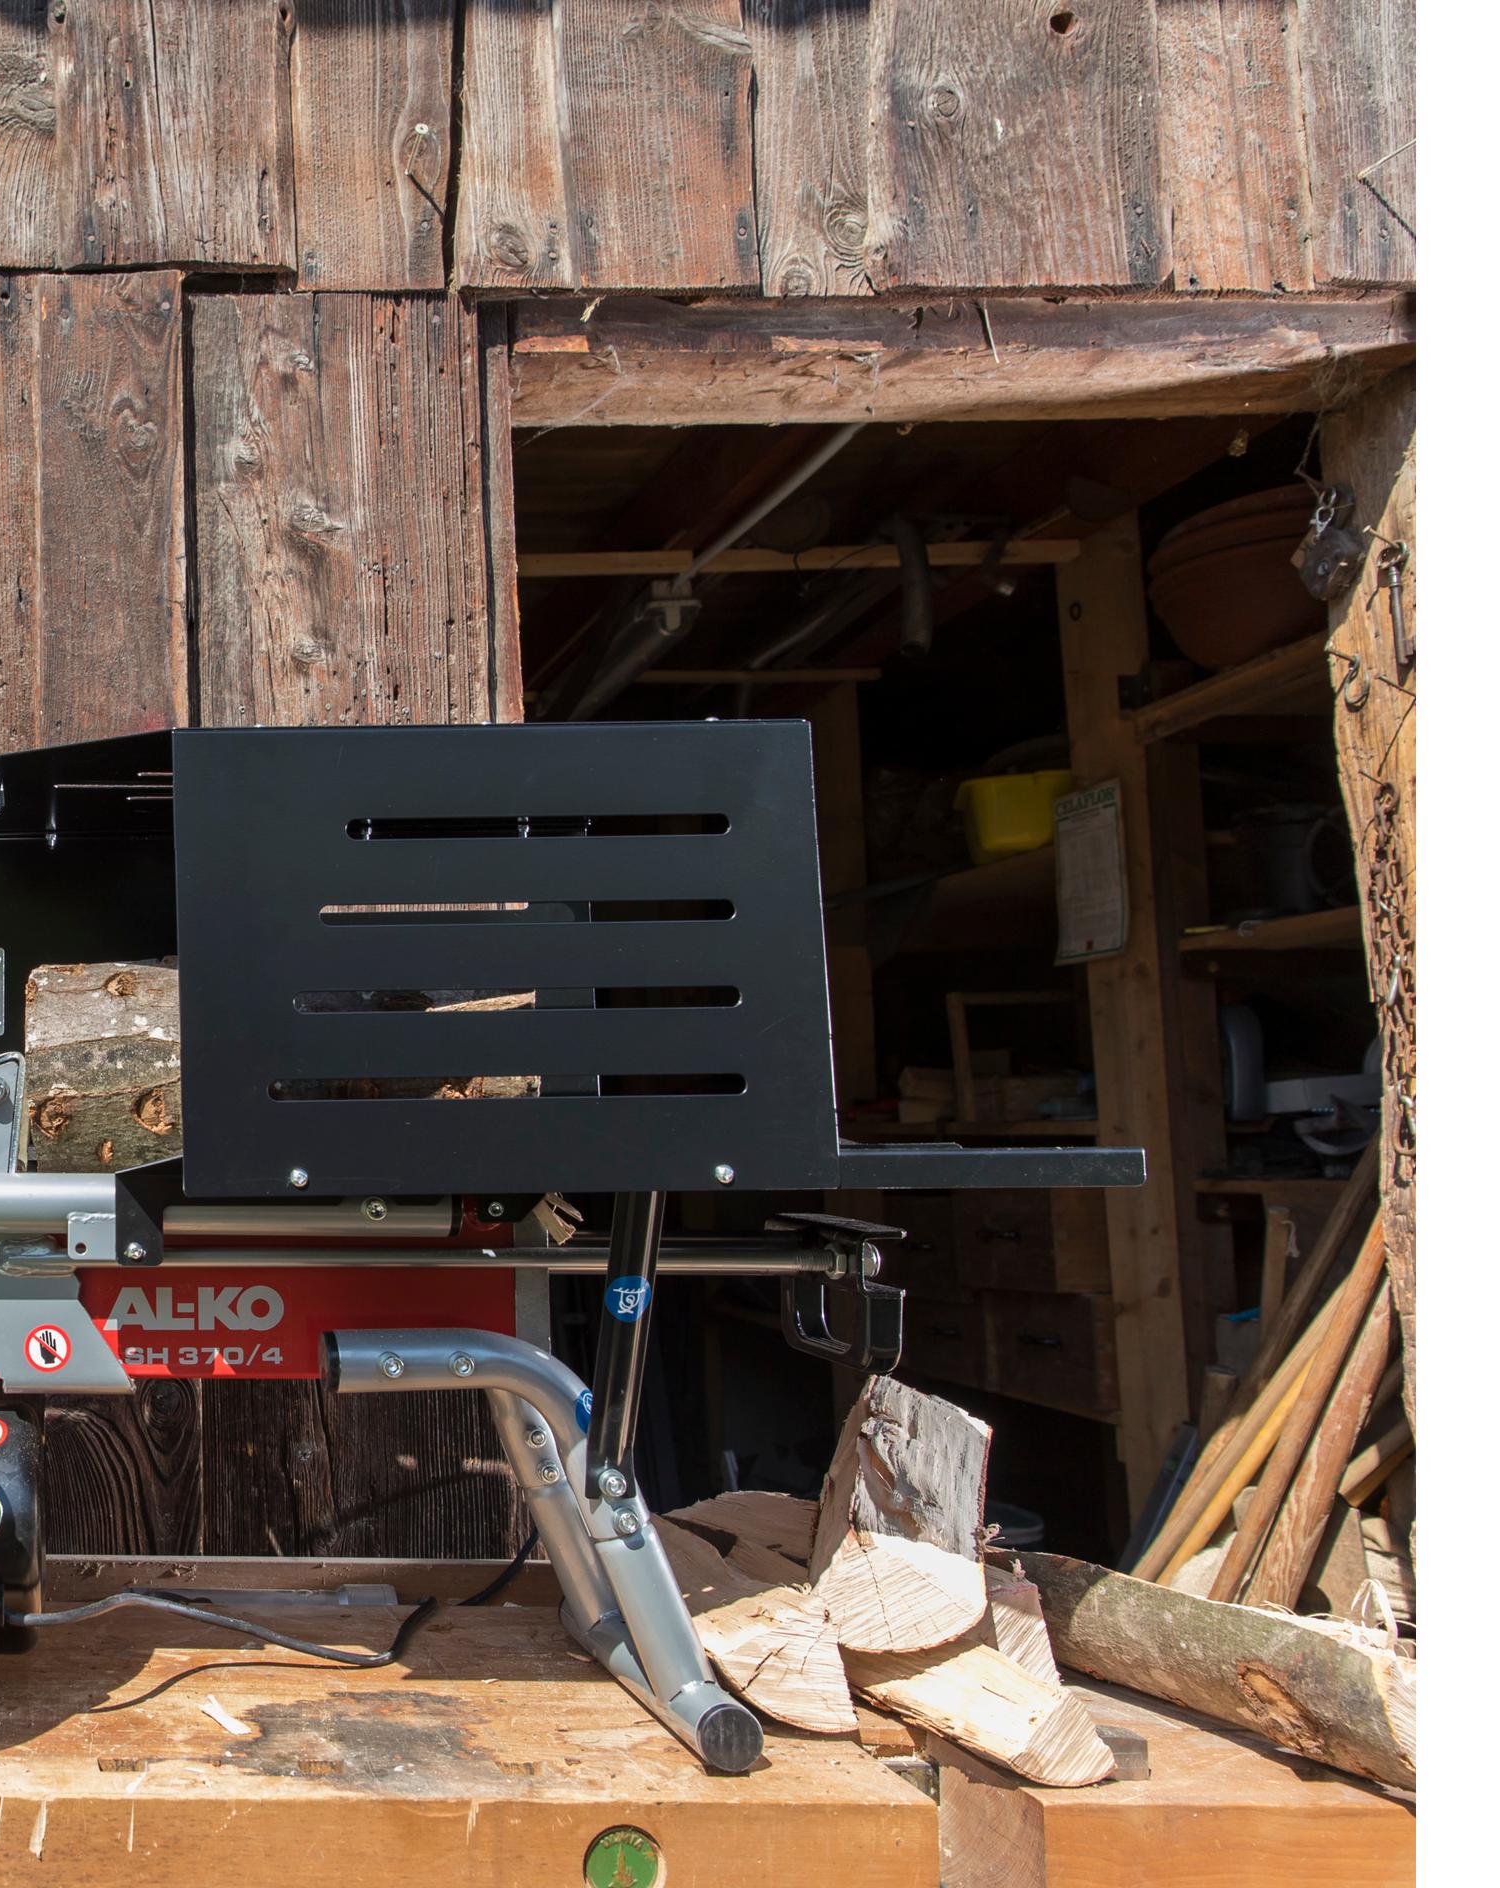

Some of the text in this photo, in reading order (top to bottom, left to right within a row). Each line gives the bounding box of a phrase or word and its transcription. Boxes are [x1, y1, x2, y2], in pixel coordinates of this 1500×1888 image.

[103, 1285, 284, 1331] AL-KO
[120, 1344, 283, 1366] SH 370/4
